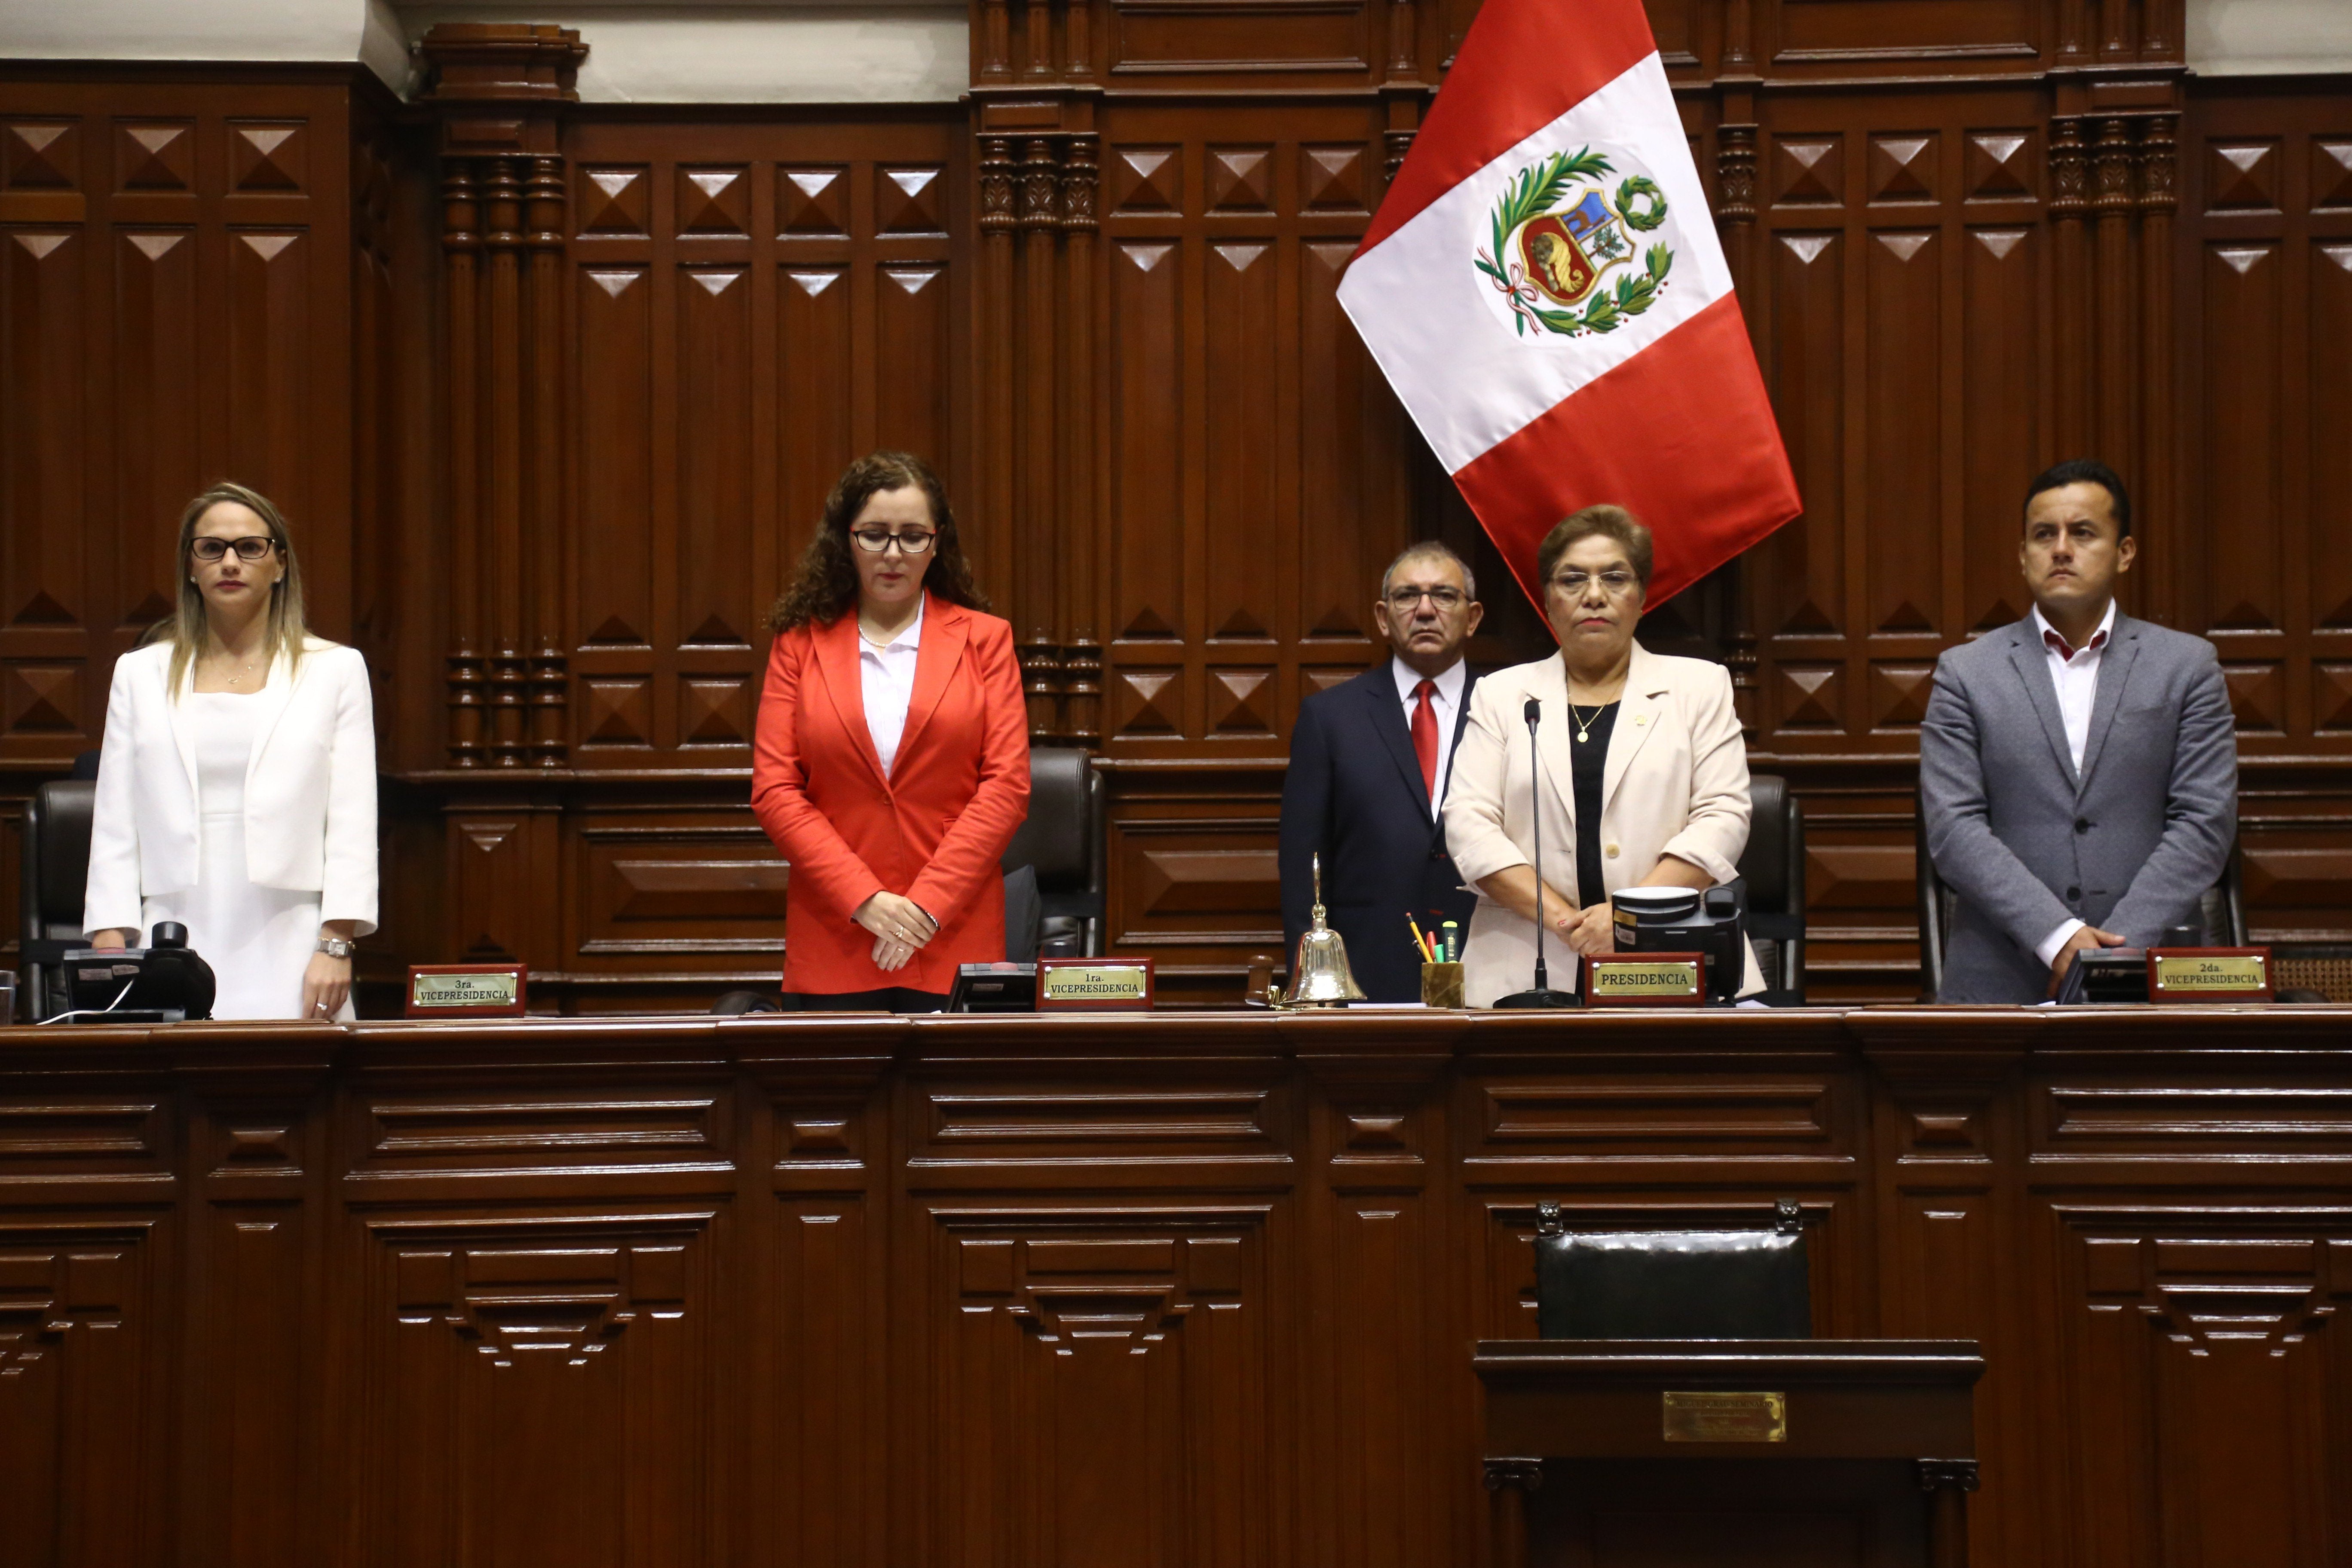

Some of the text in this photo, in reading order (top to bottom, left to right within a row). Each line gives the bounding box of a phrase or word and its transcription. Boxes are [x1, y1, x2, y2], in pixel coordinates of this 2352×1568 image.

[2200, 964, 2223, 973] 2da.
[1086, 974, 1104, 982] 1ra.
[1602, 974, 1688, 985] PRESIDENCIA
[2165, 975, 2258, 984] VICEPRESIDENCIA
[455, 980, 475, 989] 3ra.
[1051, 984, 1138, 993] VICEPRESIDENCIA
[421, 990, 508, 1000] VICEPRESIDENCIA
